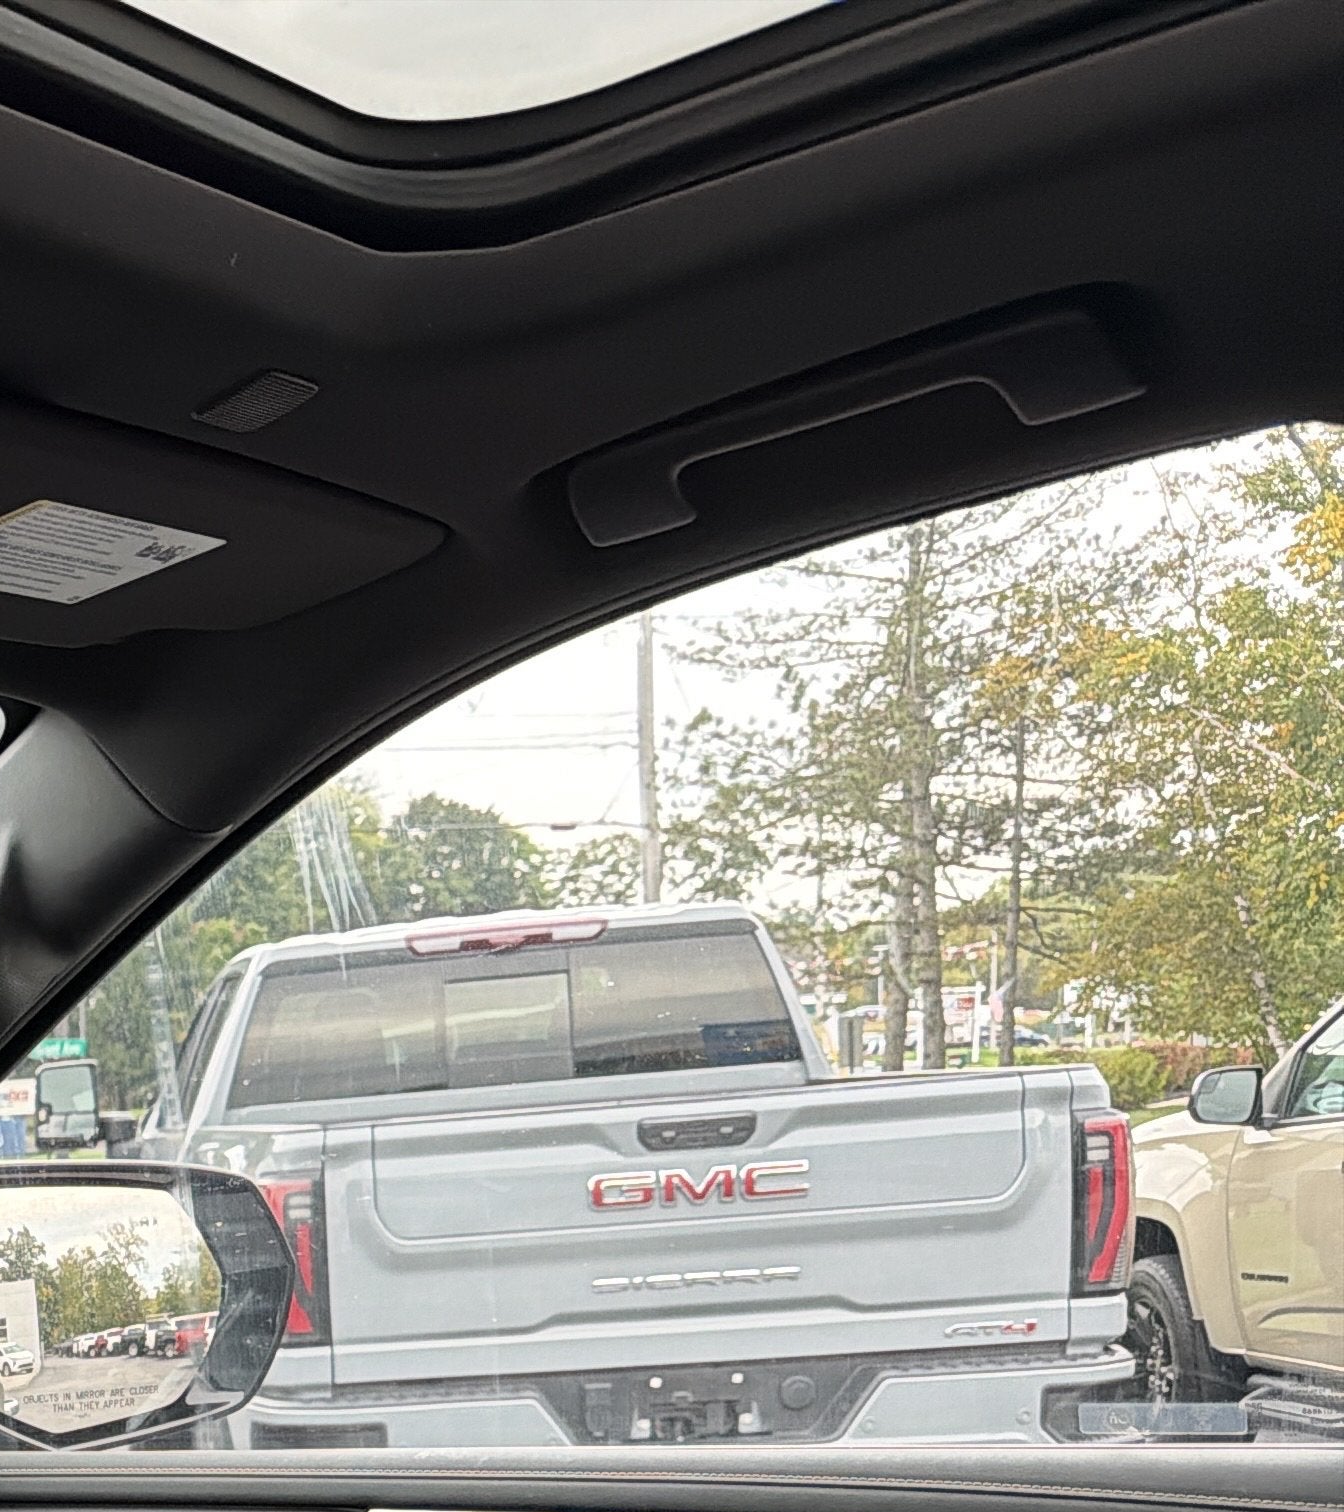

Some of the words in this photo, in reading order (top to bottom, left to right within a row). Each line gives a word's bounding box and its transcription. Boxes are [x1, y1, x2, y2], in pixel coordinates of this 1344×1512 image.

[587, 1159, 810, 1209] GMC
[23, 1394, 59, 1405] OBJECTS
[62, 1392, 72, 1401] IN
[76, 1389, 106, 1400] MIRROR
[110, 1387, 125, 1397] ARE
[129, 1384, 159, 1395] CLOSER
[53, 1402, 75, 1413] THAN
[79, 1401, 100, 1411] THEY
[103, 1398, 136, 1409] APPEAR
